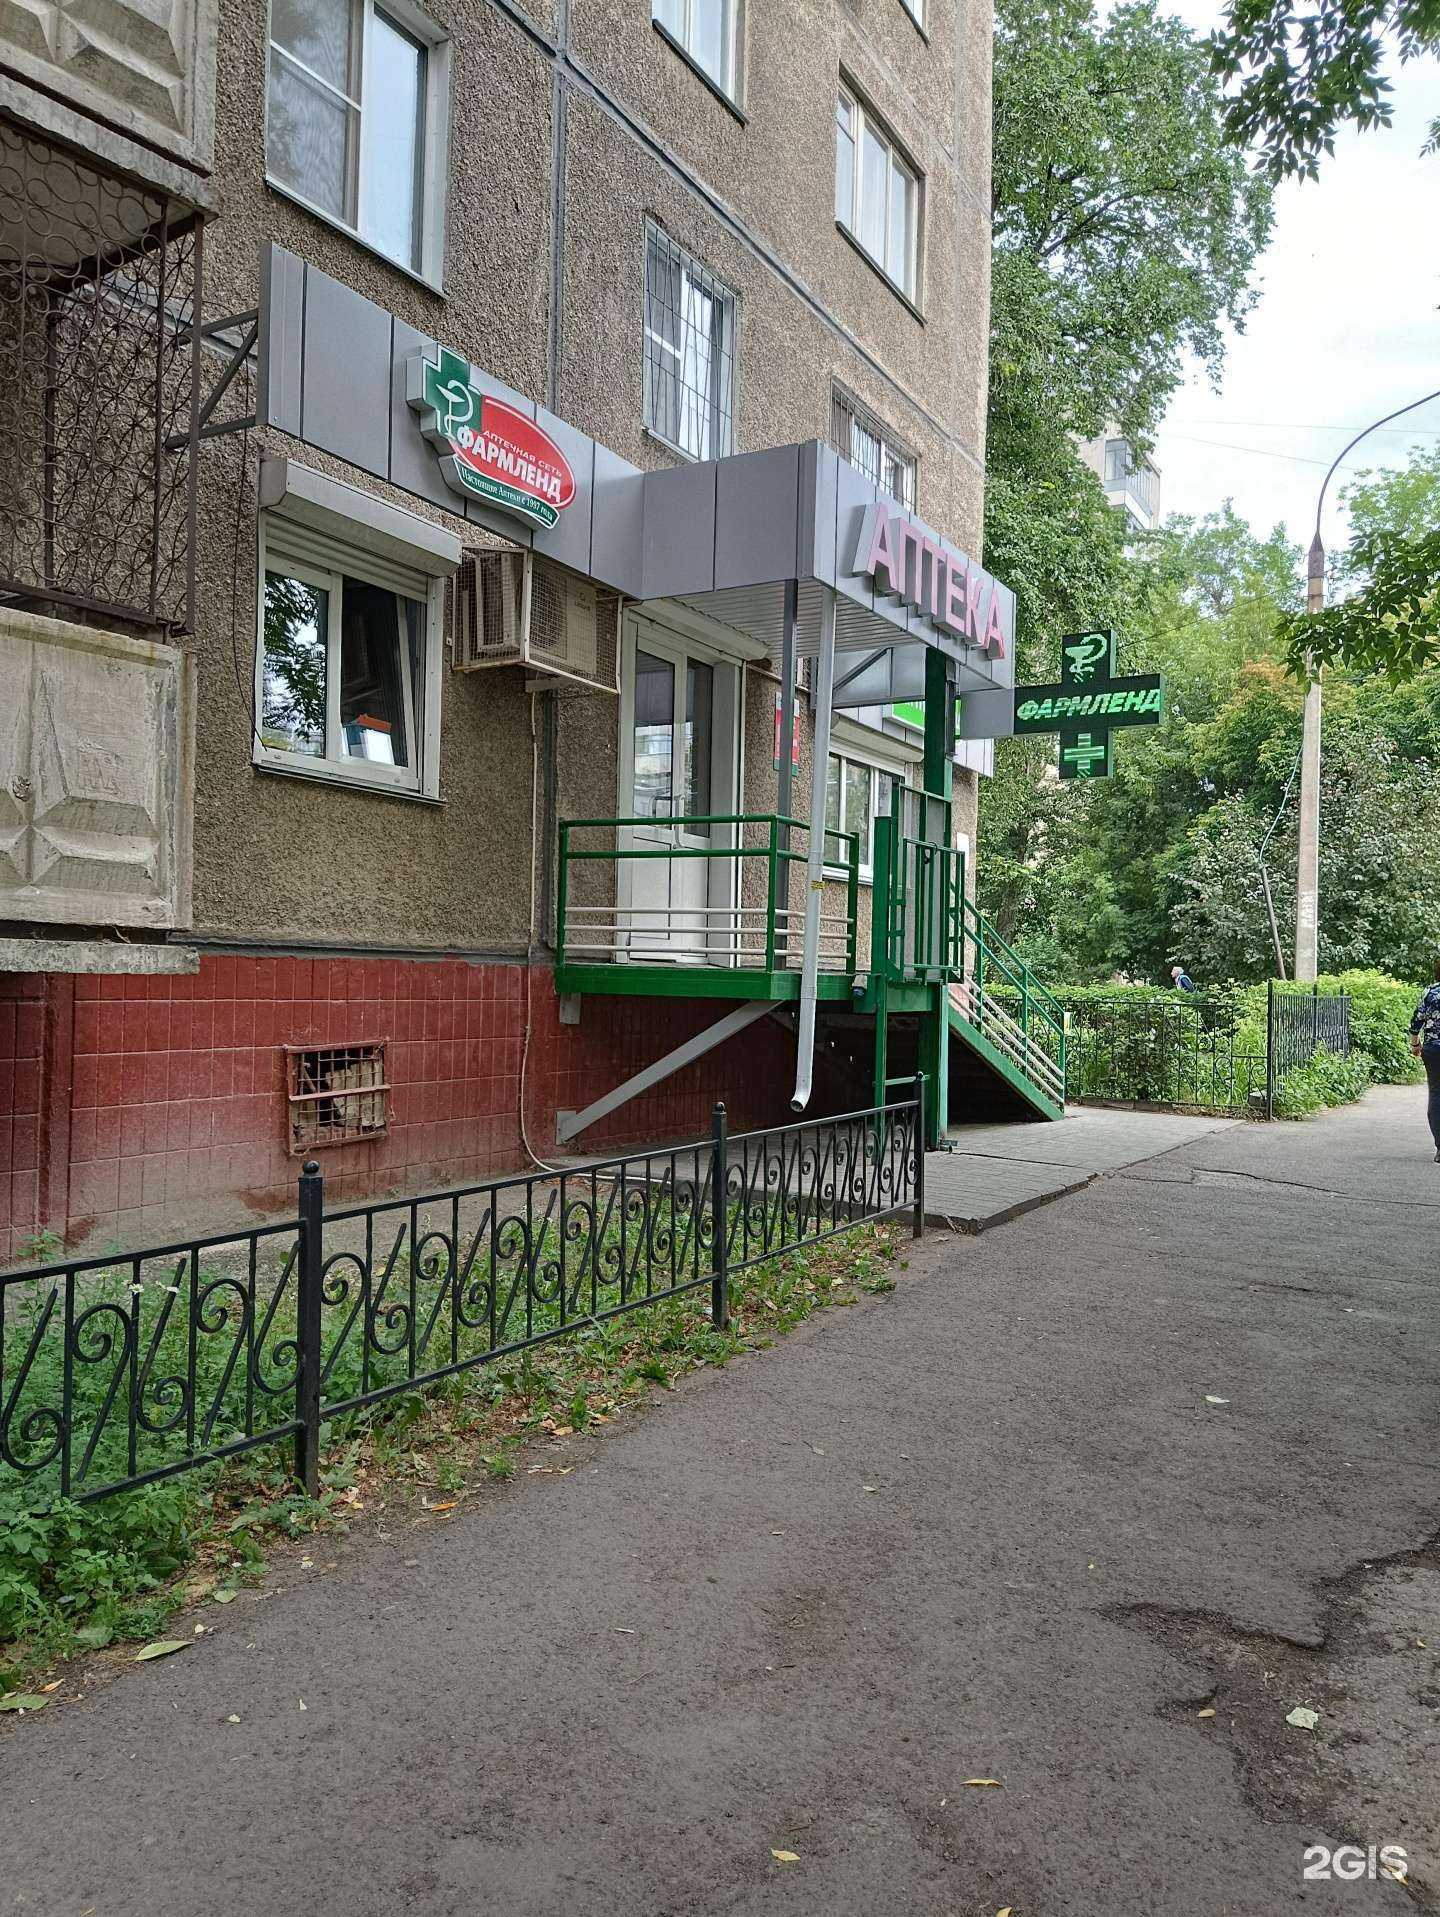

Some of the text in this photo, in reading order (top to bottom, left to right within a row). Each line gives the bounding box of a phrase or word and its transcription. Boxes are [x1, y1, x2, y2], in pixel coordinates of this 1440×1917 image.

[457, 424, 561, 503] ФАРМЛЕНД
[483, 430, 562, 477] АПТЕЧНАЯ СЕТЬ
[864, 502, 1005, 660] АПТЕКА
[1016, 688, 1160, 721] ФАРМЛЕНД
